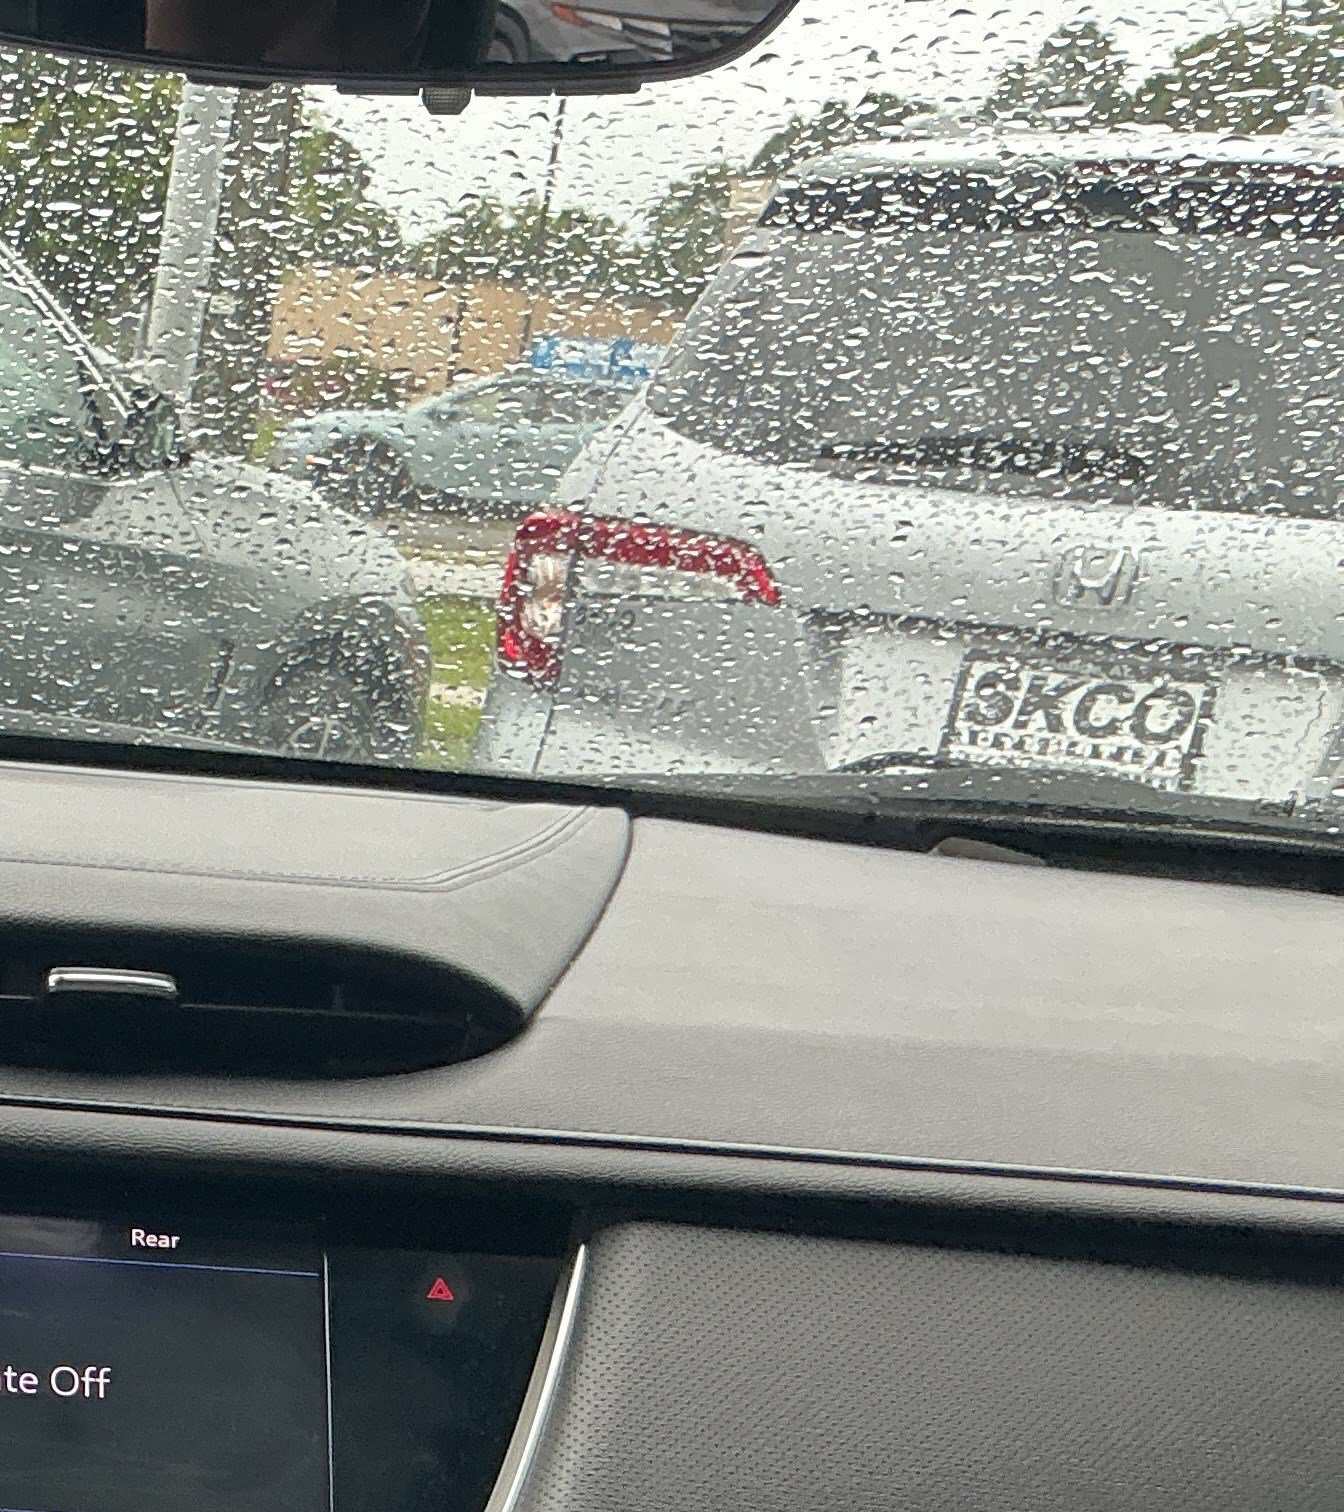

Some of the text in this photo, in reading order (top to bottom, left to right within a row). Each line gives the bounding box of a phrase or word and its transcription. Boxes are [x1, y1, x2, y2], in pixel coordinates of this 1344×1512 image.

[961, 669, 1197, 745] SKCO
[131, 1228, 181, 1250] Rear
[49, 1365, 112, 1399] Off
